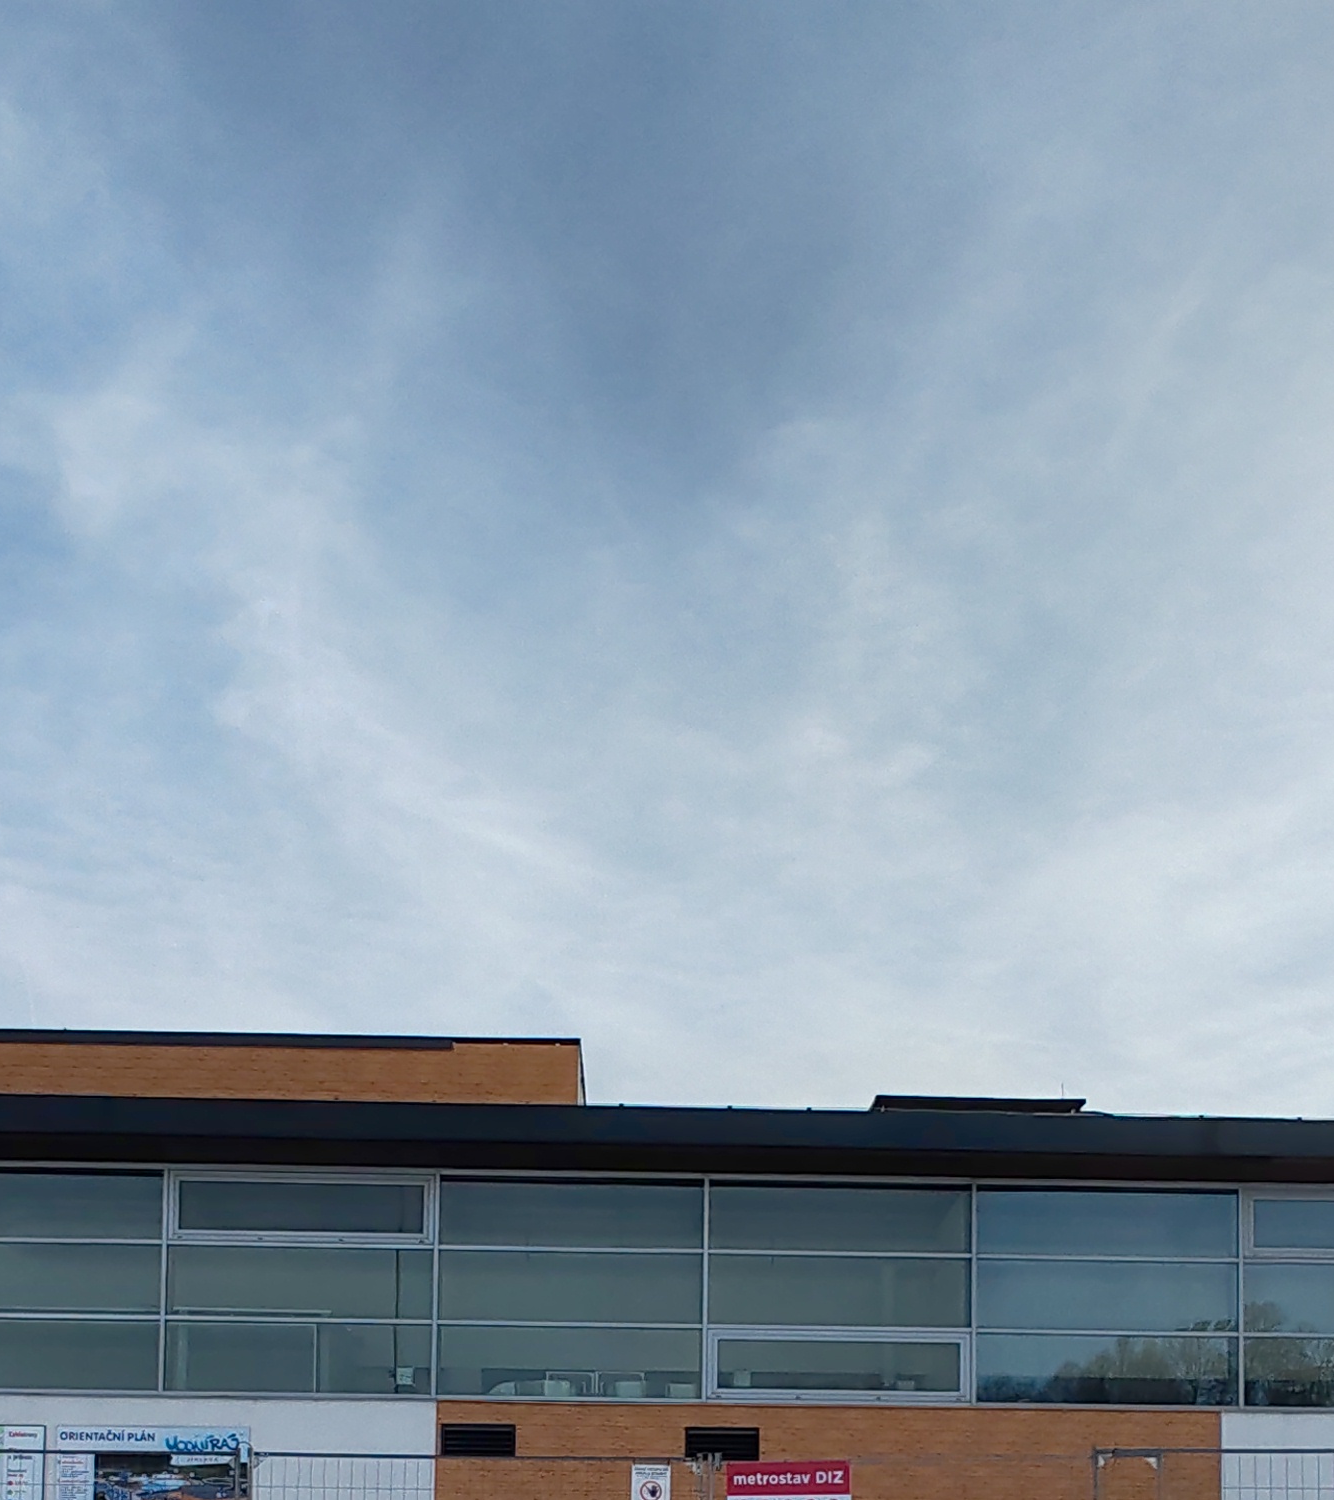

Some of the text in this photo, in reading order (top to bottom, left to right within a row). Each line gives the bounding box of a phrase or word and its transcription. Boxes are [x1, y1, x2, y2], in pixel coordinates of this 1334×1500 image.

[59, 1429, 156, 1443] ORIENTAČNÍ PLÁN
[733, 1470, 844, 1486] metrostav DIZ
